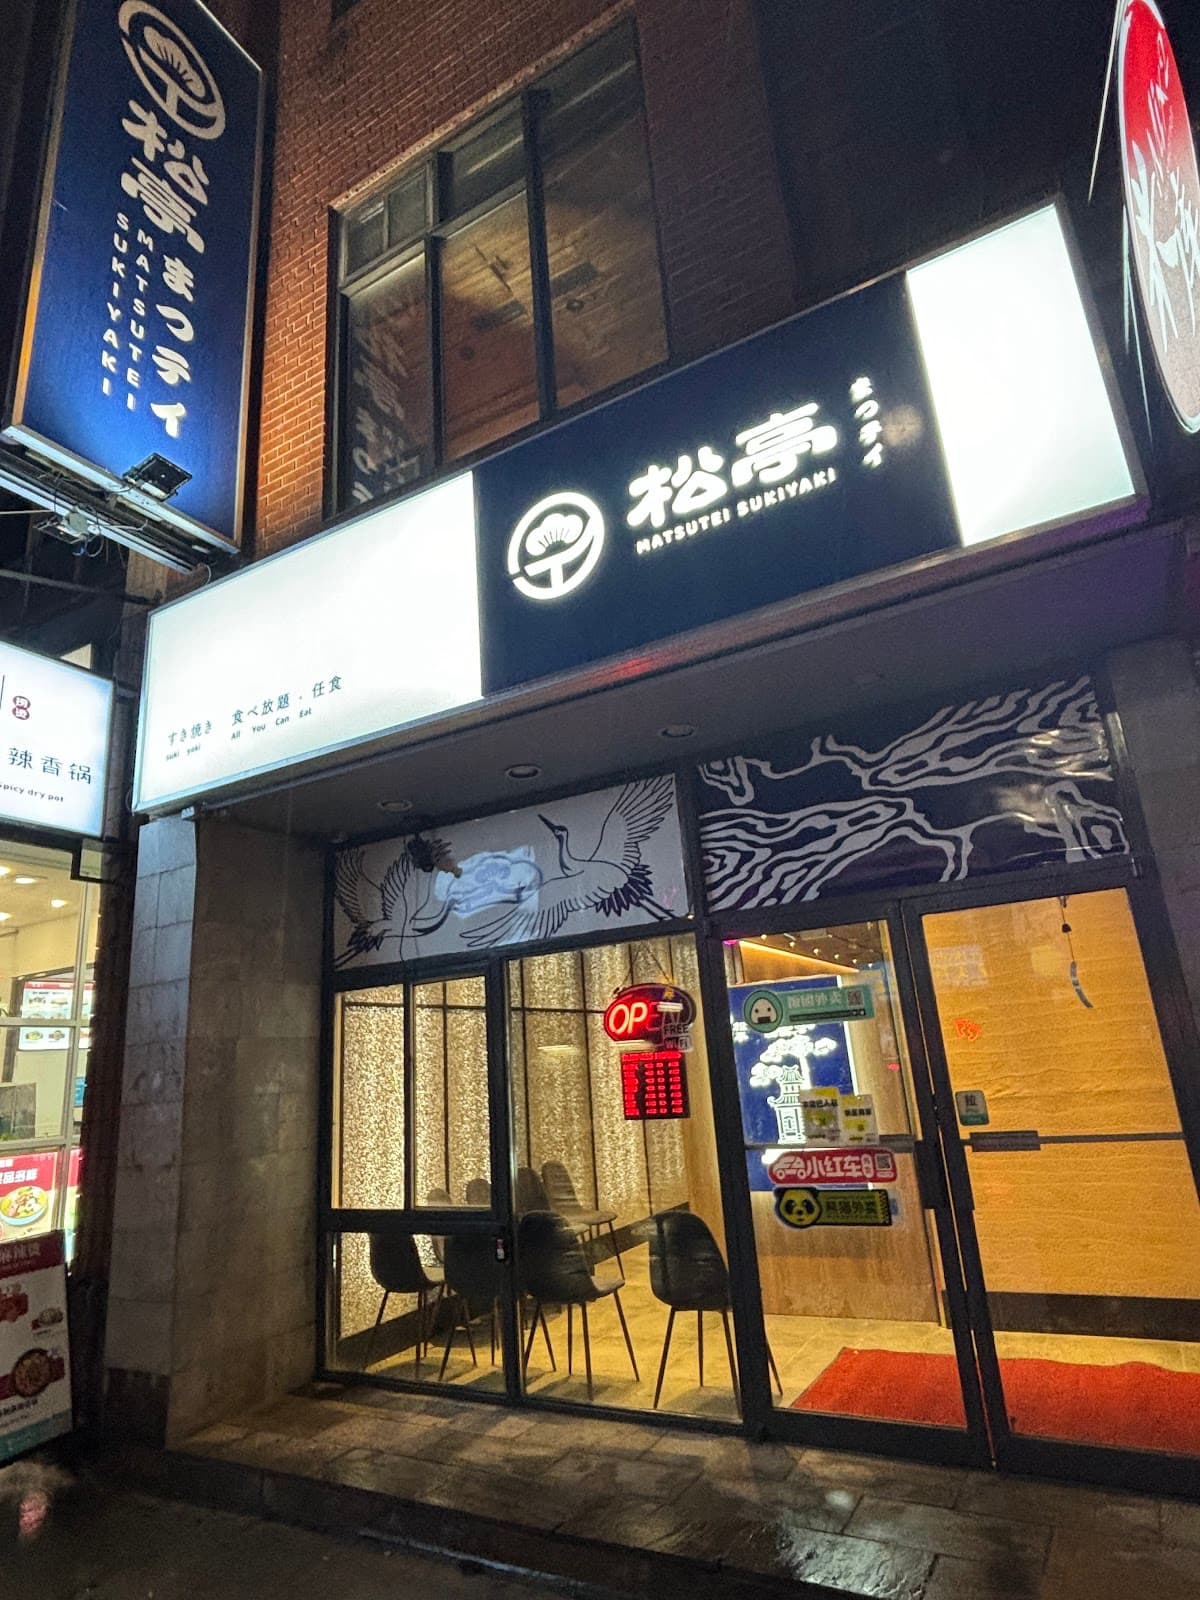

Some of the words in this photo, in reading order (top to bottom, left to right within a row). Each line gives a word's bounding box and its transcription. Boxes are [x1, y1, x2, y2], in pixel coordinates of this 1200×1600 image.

[103, 212, 129, 396] SUKIYAKI
[126, 229, 154, 411] MATSUTEI
[626, 402, 838, 529] 松亭
[635, 507, 730, 556] MATSUTEI
[737, 467, 836, 518] SUKIYAKI
[231, 730, 241, 740] All
[252, 724, 266, 734] You
[275, 715, 290, 726] Can
[299, 707, 312, 718] Eat
[8, 747, 92, 785] 辣香锅
[0, 784, 24, 794] picy
[27, 789, 46, 799] dry
[664, 1023, 688, 1035] FREE
[806, 1155, 862, 1178] 小红车
